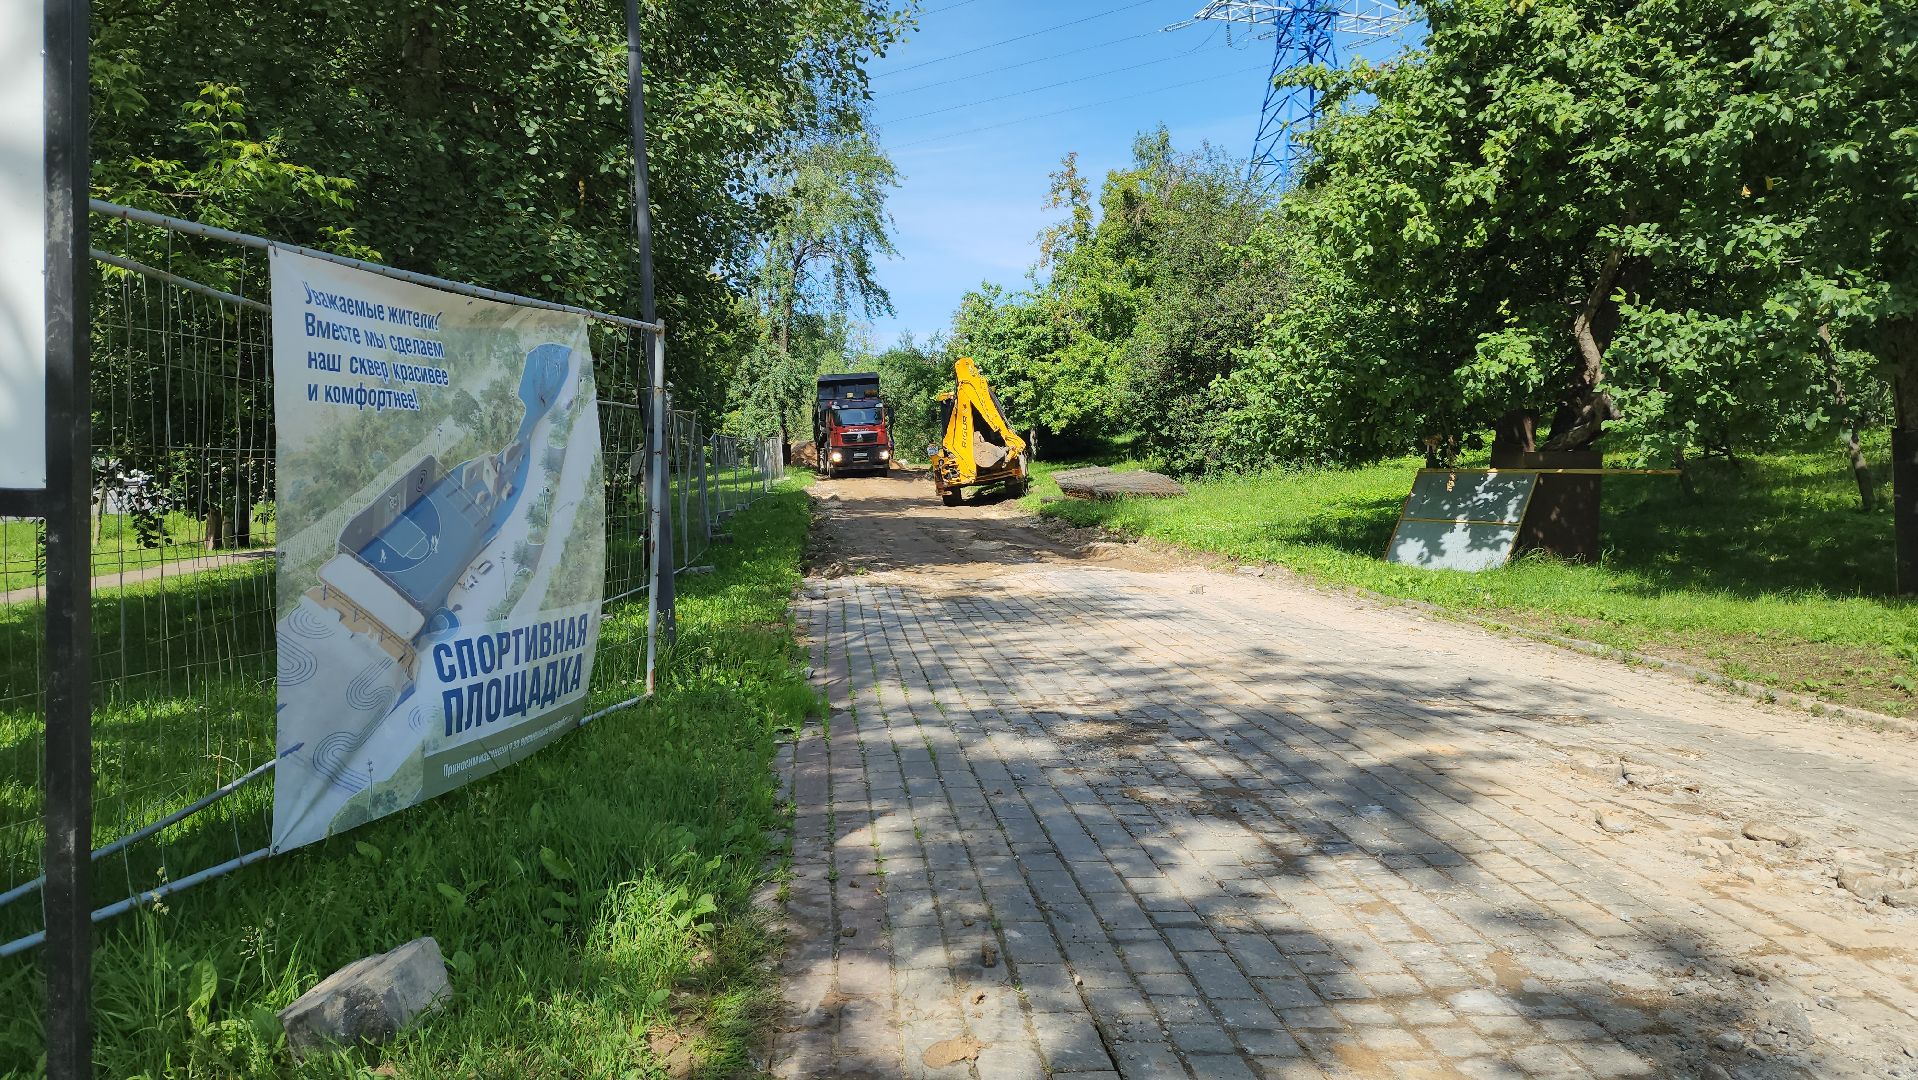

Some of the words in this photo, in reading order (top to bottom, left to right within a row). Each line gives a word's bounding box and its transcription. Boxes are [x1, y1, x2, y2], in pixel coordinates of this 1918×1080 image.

[302, 280, 385, 322] Уважаемые
[388, 304, 443, 332] жители!
[305, 312, 361, 345] Вместе
[365, 329, 387, 350] мы
[389, 333, 445, 359] сделаем
[307, 351, 342, 373] наш
[349, 355, 388, 384] сквер
[392, 363, 449, 386] красивее
[307, 383, 319, 402] и
[324, 383, 420, 411] комфортнее!
[432, 613, 588, 683] СПОРТИВНАЯ
[441, 652, 583, 737] ПЛОЩАДКА
[443, 755, 479, 778] Приносим
